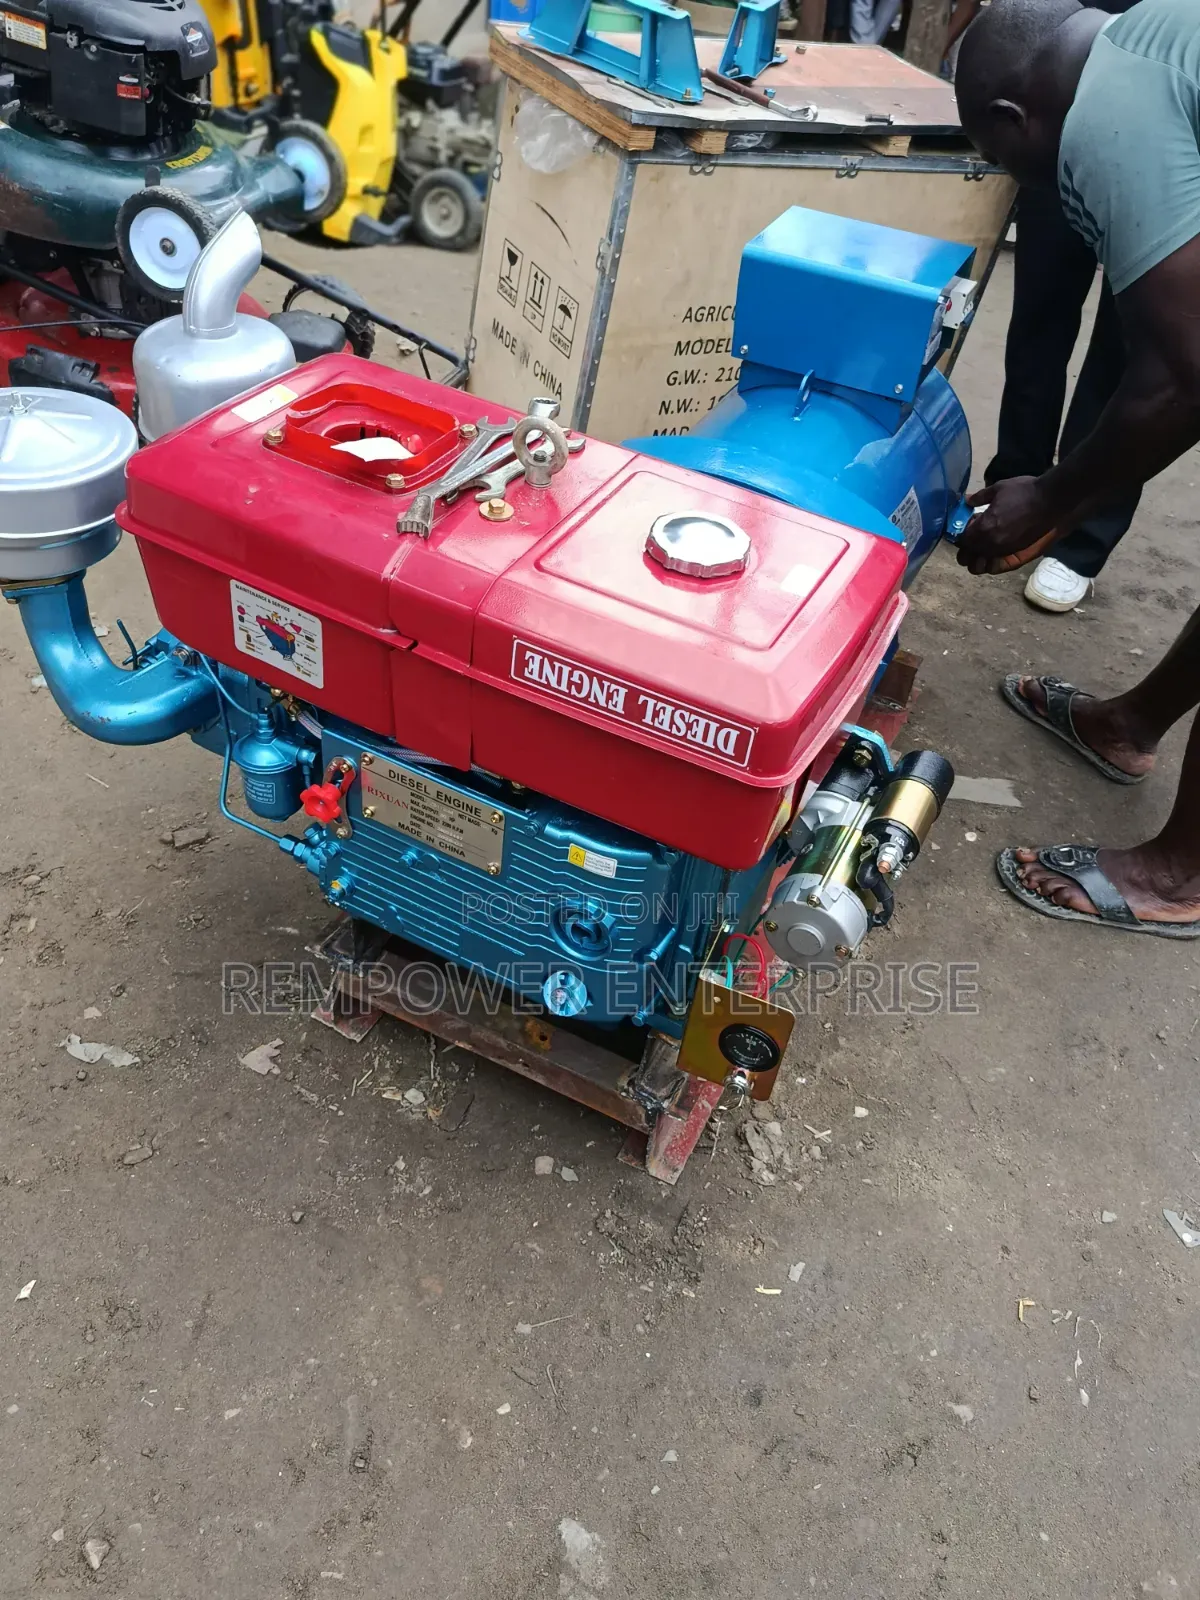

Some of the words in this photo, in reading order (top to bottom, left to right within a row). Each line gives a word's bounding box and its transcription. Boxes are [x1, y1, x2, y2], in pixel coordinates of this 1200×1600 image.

[492, 318, 517, 355] MADE
[520, 350, 530, 368] IN
[533, 360, 562, 400] CHINA
[666, 369, 708, 386] G.W.:
[658, 398, 700, 415] N.W.:
[271, 600, 290, 612] SERVICE
[524, 650, 629, 715] ENGINE
[638, 695, 740, 756] DIESEL
[367, 785, 409, 810] RIXUAN
[388, 769, 431, 795] DIESEL
[436, 790, 482, 818] ENGINE
[397, 822, 422, 838] MADE
[426, 835, 435, 844] IN
[439, 841, 466, 858] CHINA
